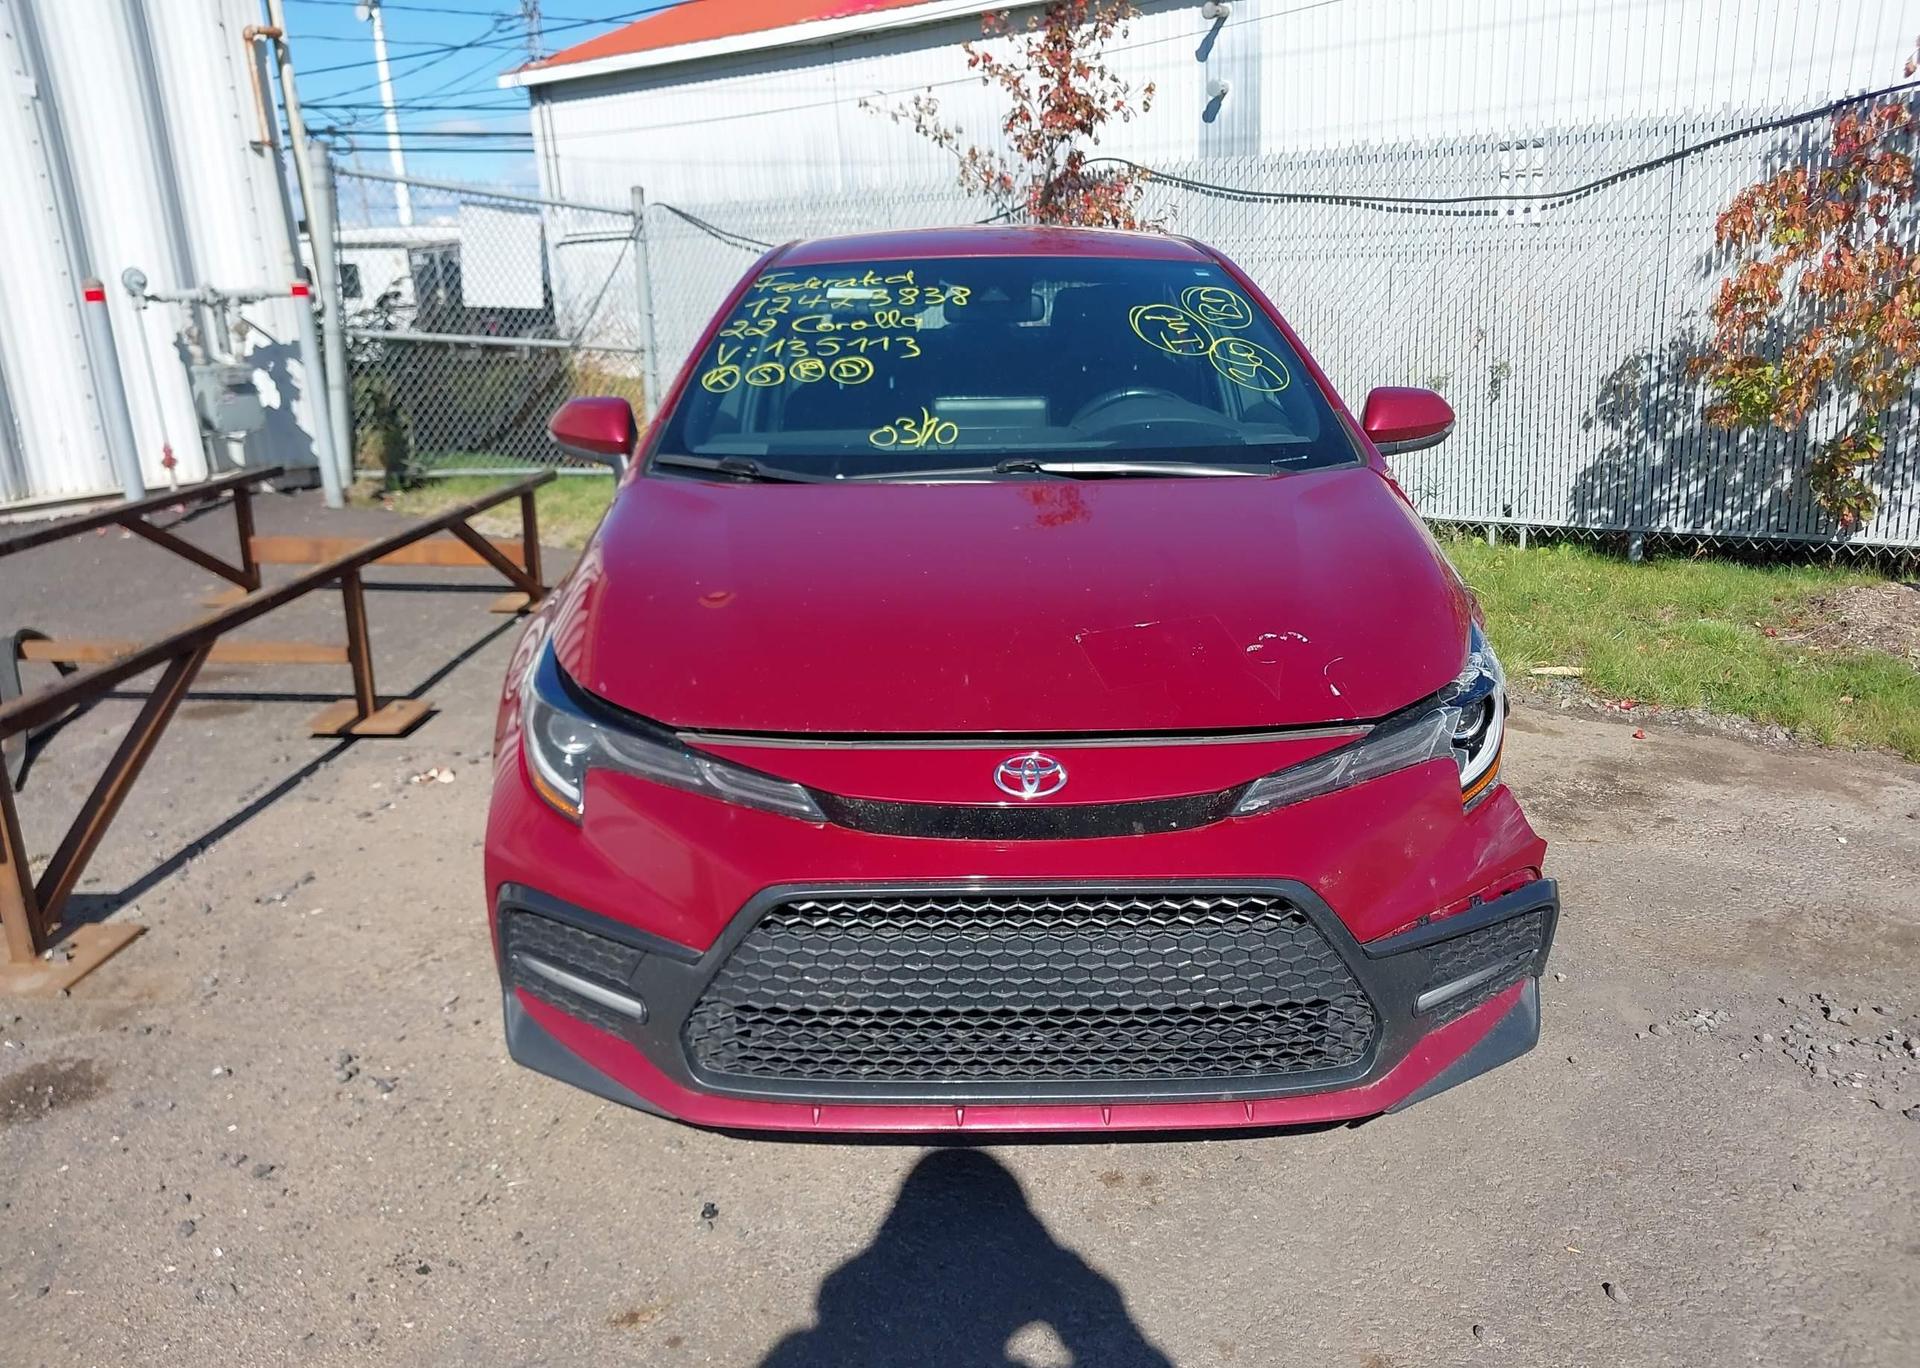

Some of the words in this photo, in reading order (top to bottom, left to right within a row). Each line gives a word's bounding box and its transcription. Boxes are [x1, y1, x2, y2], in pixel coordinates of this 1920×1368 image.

[754, 270, 915, 295] Federated
[719, 318, 777, 340] 22
[792, 310, 924, 332] Corolla
